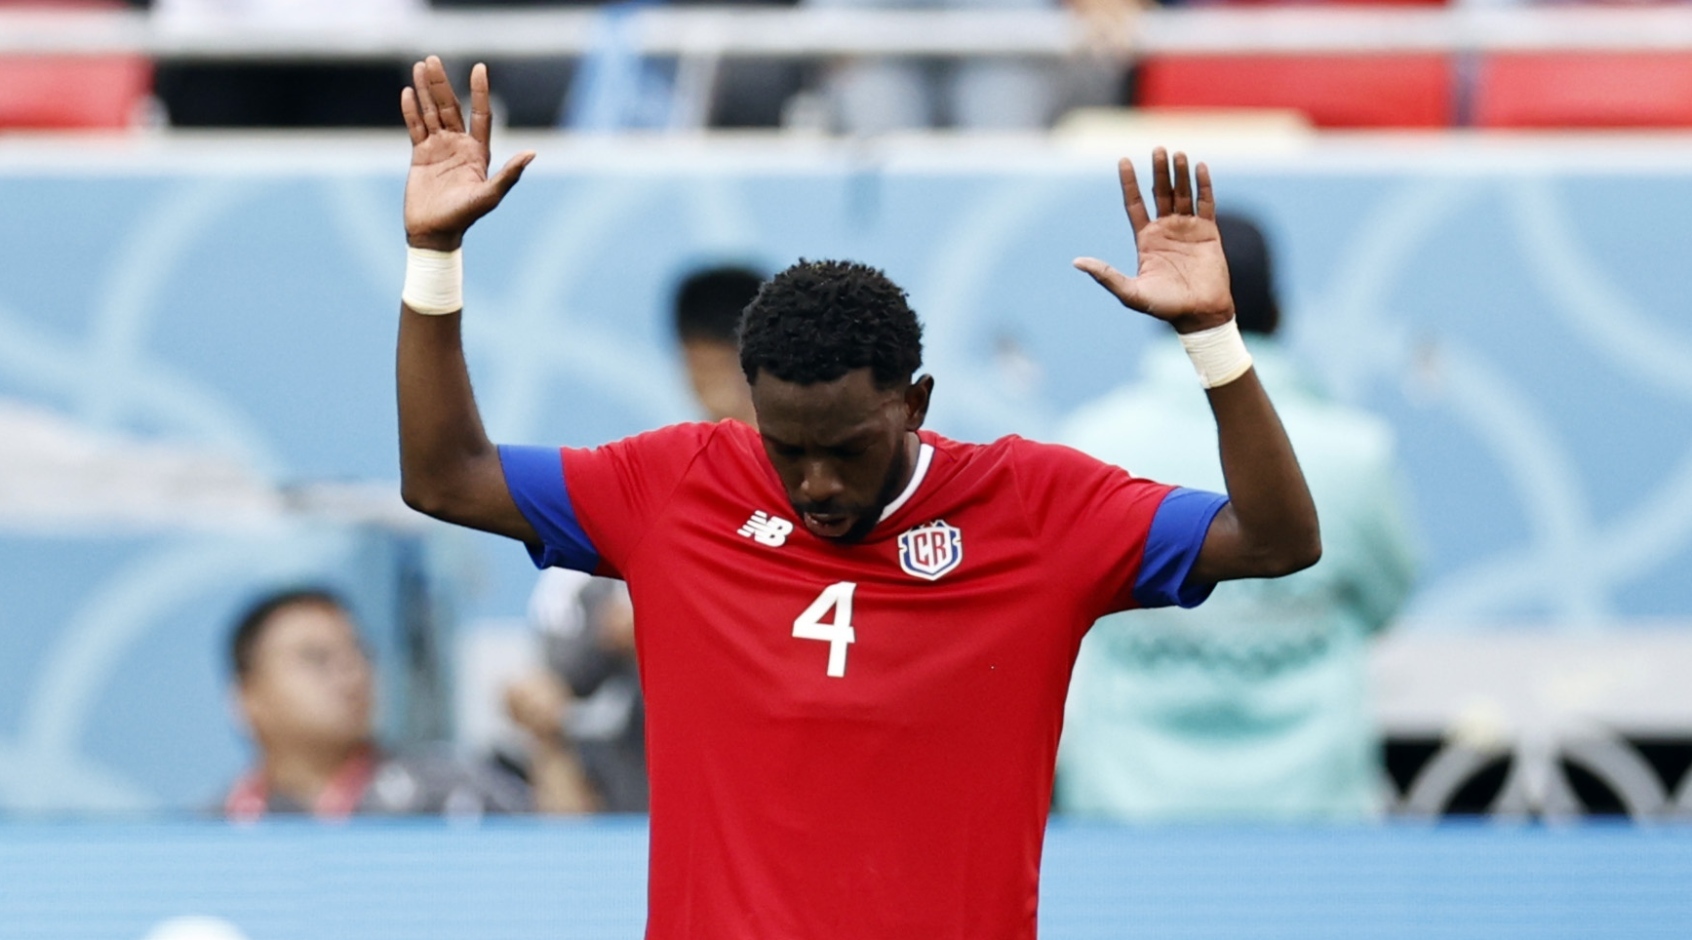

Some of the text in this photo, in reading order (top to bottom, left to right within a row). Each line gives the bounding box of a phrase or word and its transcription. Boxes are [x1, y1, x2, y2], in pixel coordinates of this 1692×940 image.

[737, 510, 793, 547] NB
[914, 531, 947, 567] CR
[792, 581, 857, 677] 4
